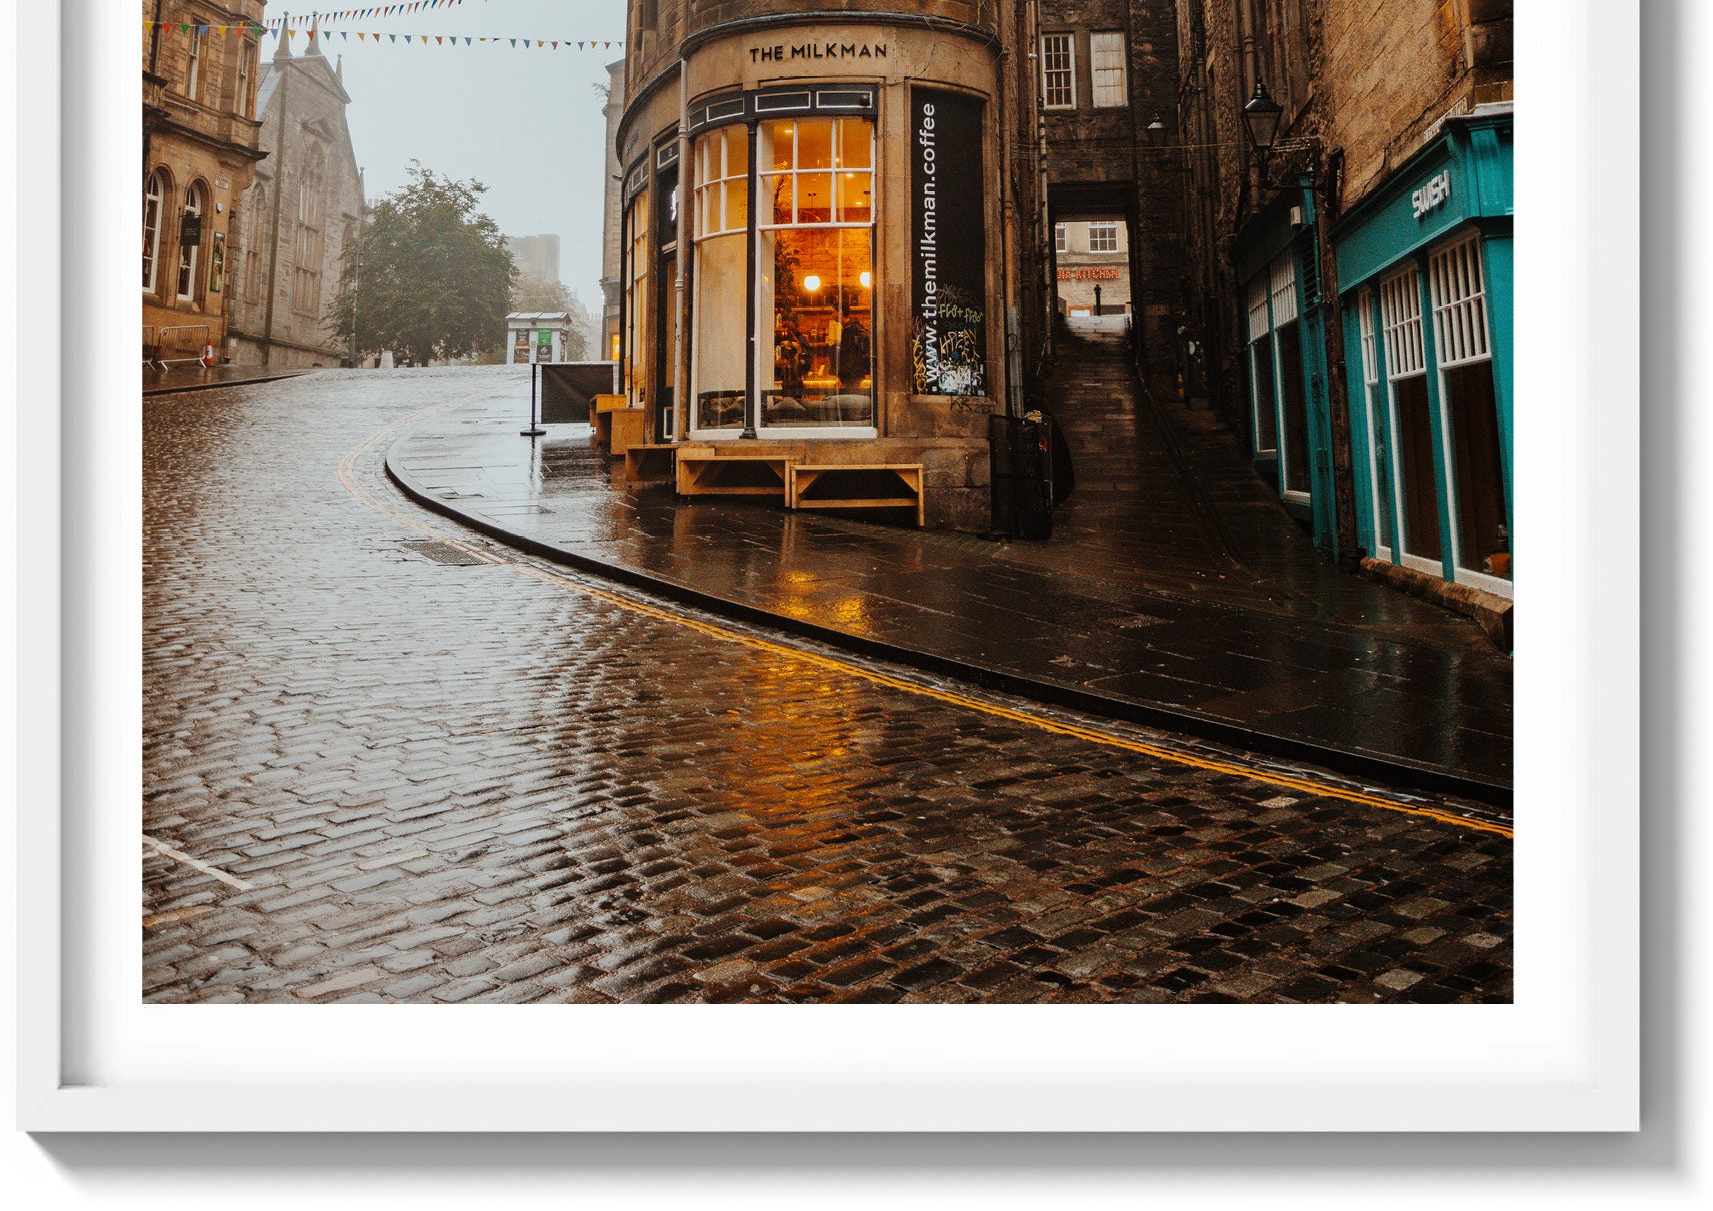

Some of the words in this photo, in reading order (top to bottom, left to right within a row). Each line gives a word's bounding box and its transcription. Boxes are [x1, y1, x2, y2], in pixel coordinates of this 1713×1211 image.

[750, 45, 784, 62] THE
[791, 42, 887, 58] MILKMAN
[1412, 169, 1450, 219] SWISH
[919, 102, 938, 383] www.themilkman.coffee
